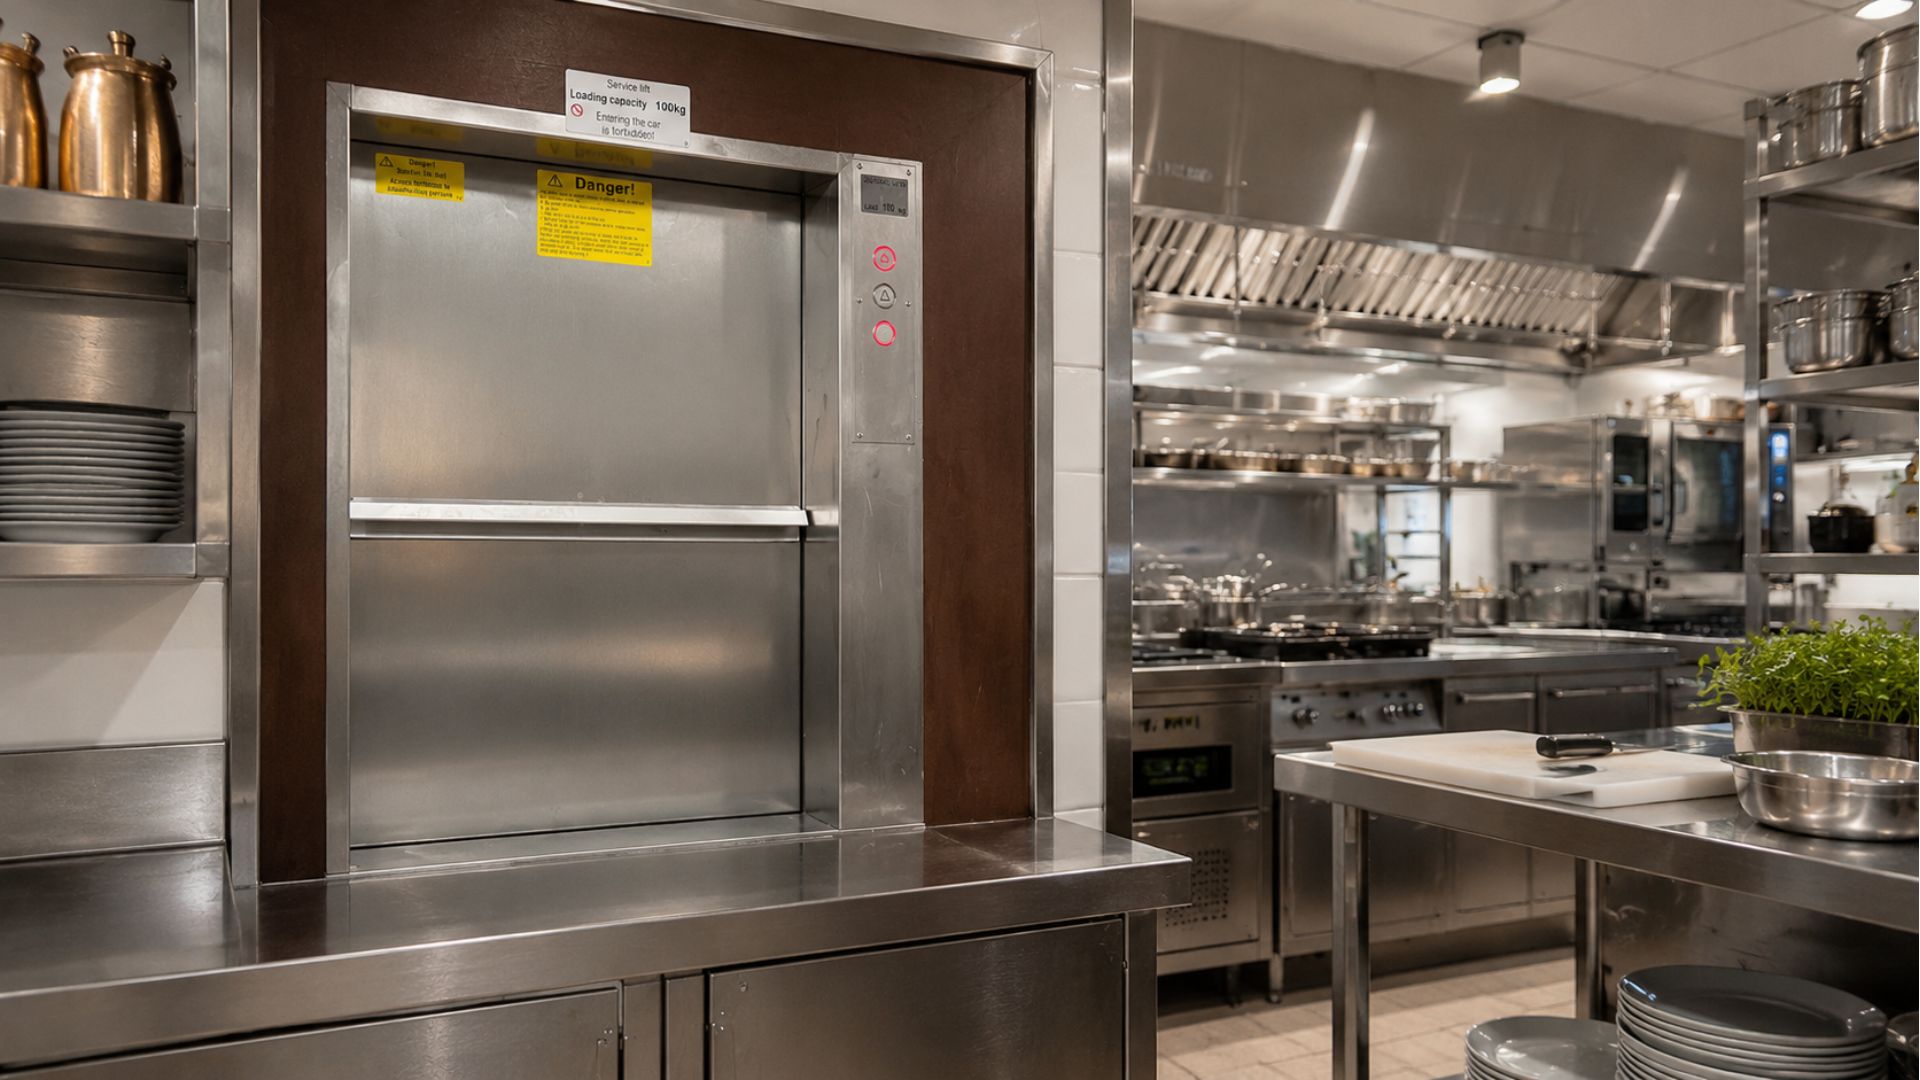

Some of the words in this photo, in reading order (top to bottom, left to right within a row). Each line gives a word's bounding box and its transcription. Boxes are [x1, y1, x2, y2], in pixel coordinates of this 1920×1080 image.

[607, 79, 638, 92] Service
[640, 84, 651, 93] lift
[570, 89, 608, 105] Loading
[609, 96, 647, 111] capacity
[656, 101, 686, 116] 100kg
[596, 111, 631, 127] Entering
[575, 176, 635, 196] Danger!
